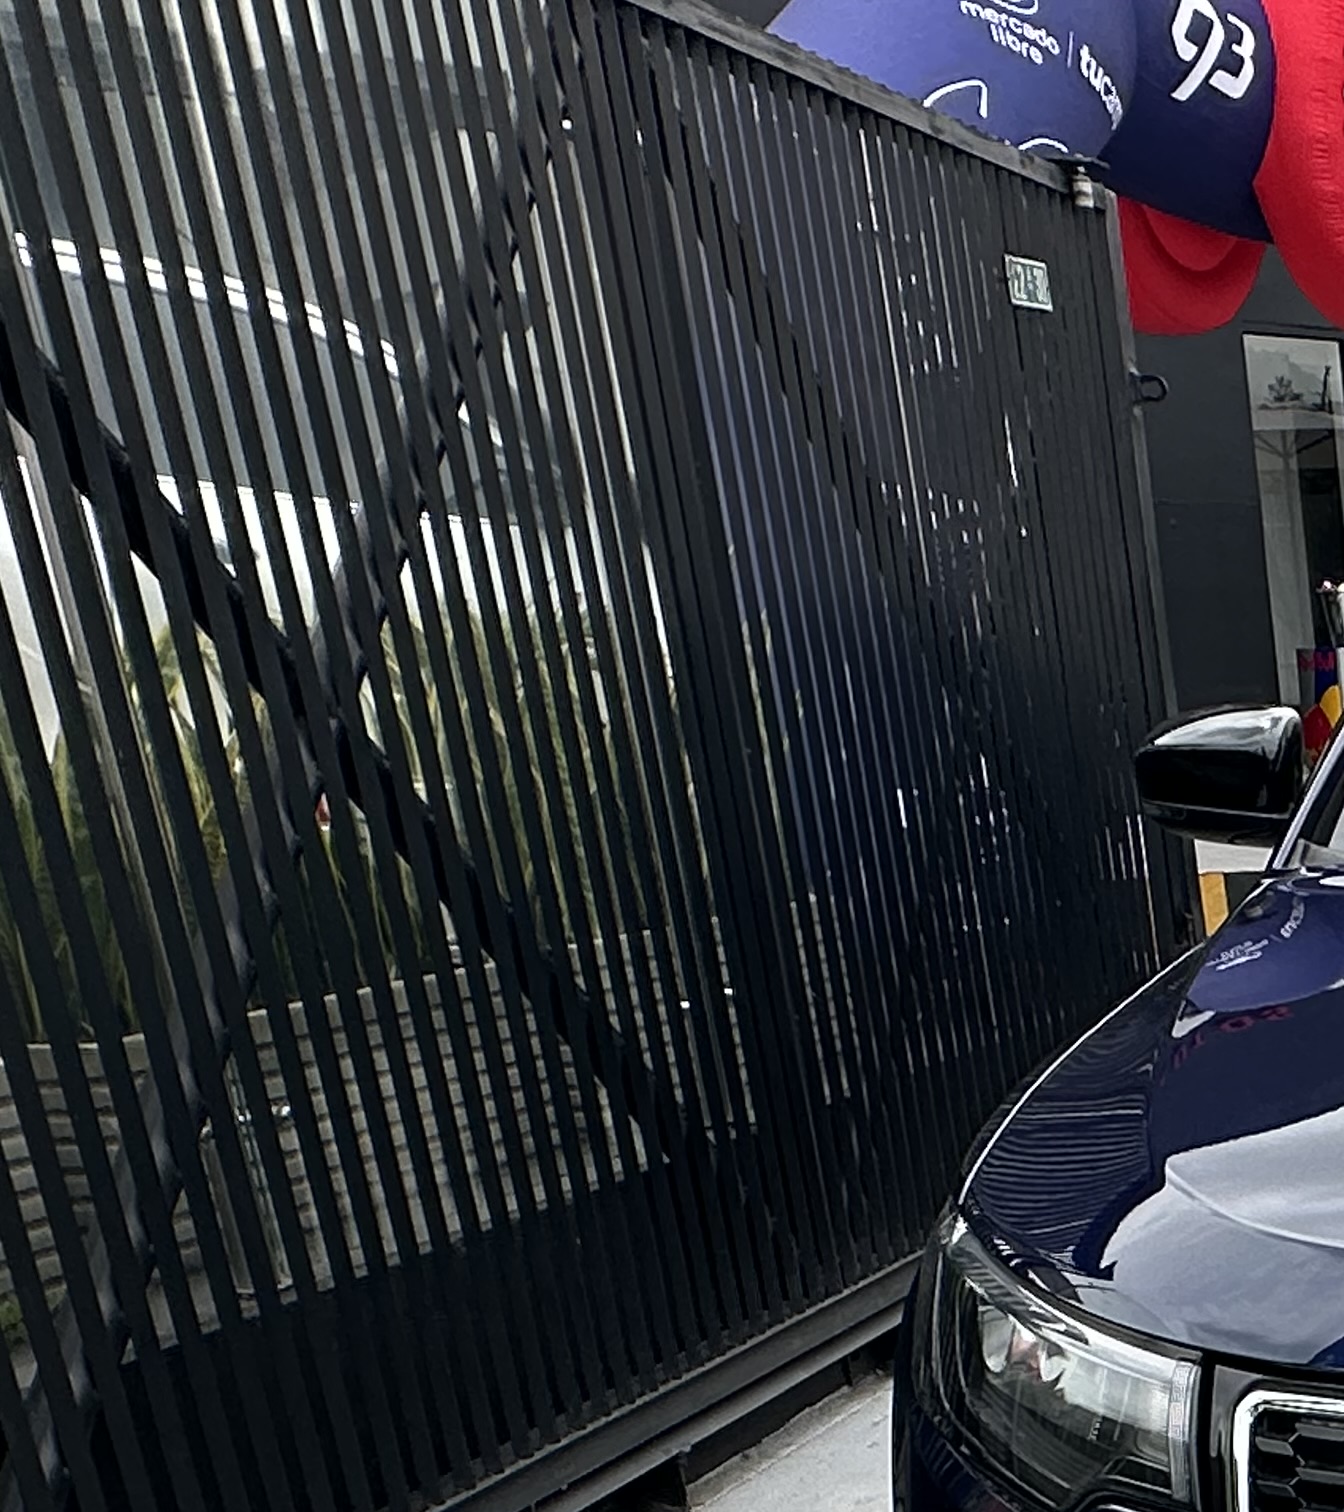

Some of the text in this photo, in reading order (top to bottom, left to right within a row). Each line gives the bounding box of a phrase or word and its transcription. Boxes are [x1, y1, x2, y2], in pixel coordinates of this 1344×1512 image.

[960, 0, 1061, 56] mercado
[990, 23, 1044, 65] libre
[1170, 0, 1256, 101] 93
